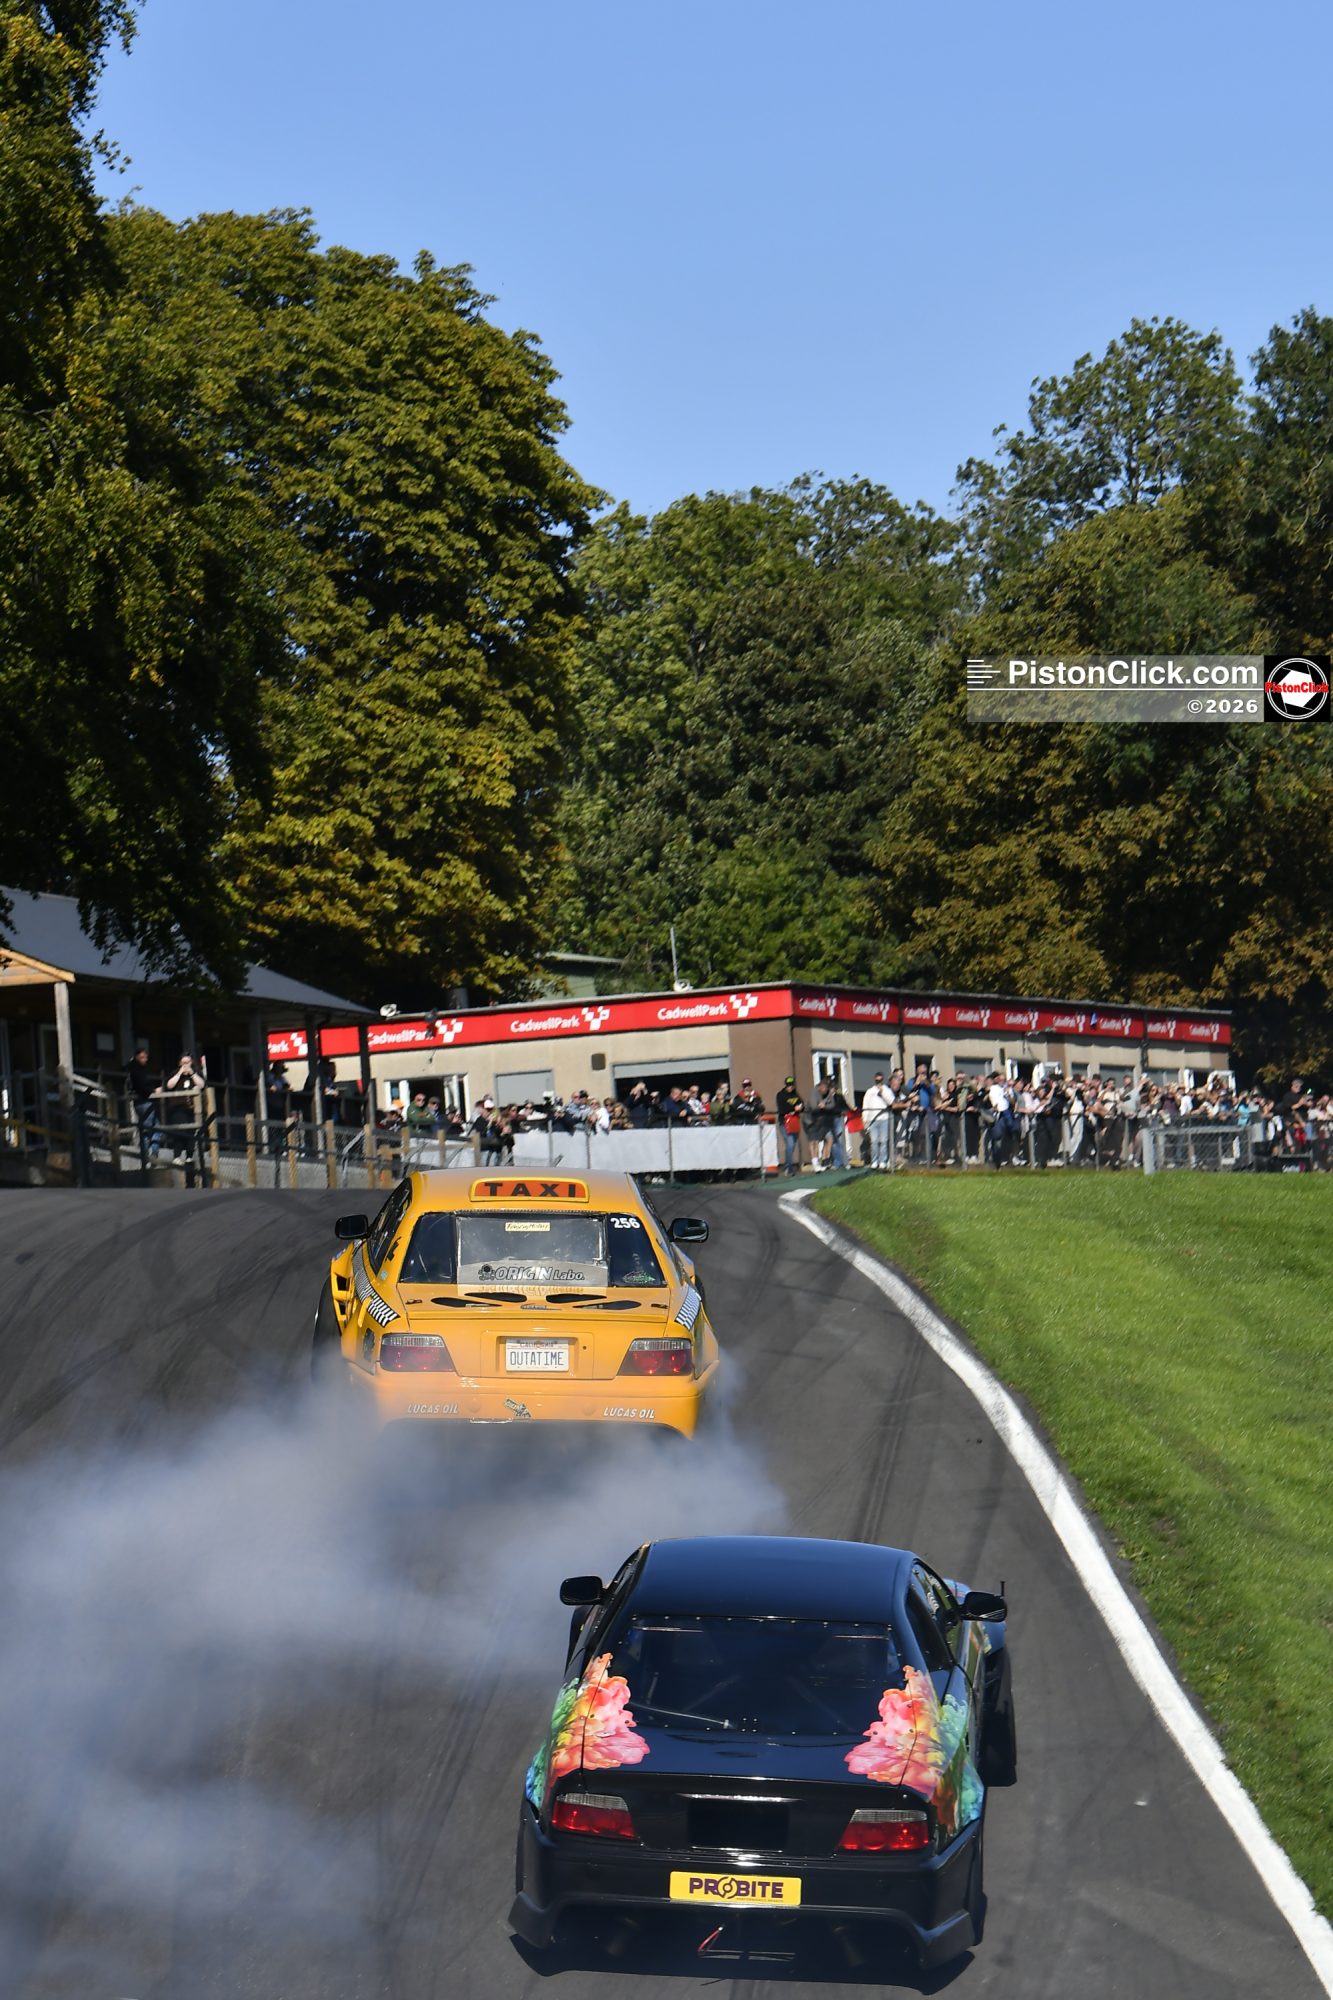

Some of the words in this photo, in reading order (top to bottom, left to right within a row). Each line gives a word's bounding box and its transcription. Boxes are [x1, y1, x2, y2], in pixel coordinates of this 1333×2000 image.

[657, 1003, 728, 1021] CadwellPark
[510, 1015, 580, 1033] CadwellPark
[484, 1182, 576, 1198] TAXI
[610, 1217, 641, 1229] 256
[495, 1266, 553, 1281] ORIGIN
[510, 1351, 565, 1366] OUTATIME
[407, 1403, 440, 1414] LUCAS
[442, 1403, 459, 1414] OIL
[603, 1407, 637, 1418] LUCAS
[639, 1409, 655, 1419] OIL
[689, 1876, 784, 1899] PROBITE
